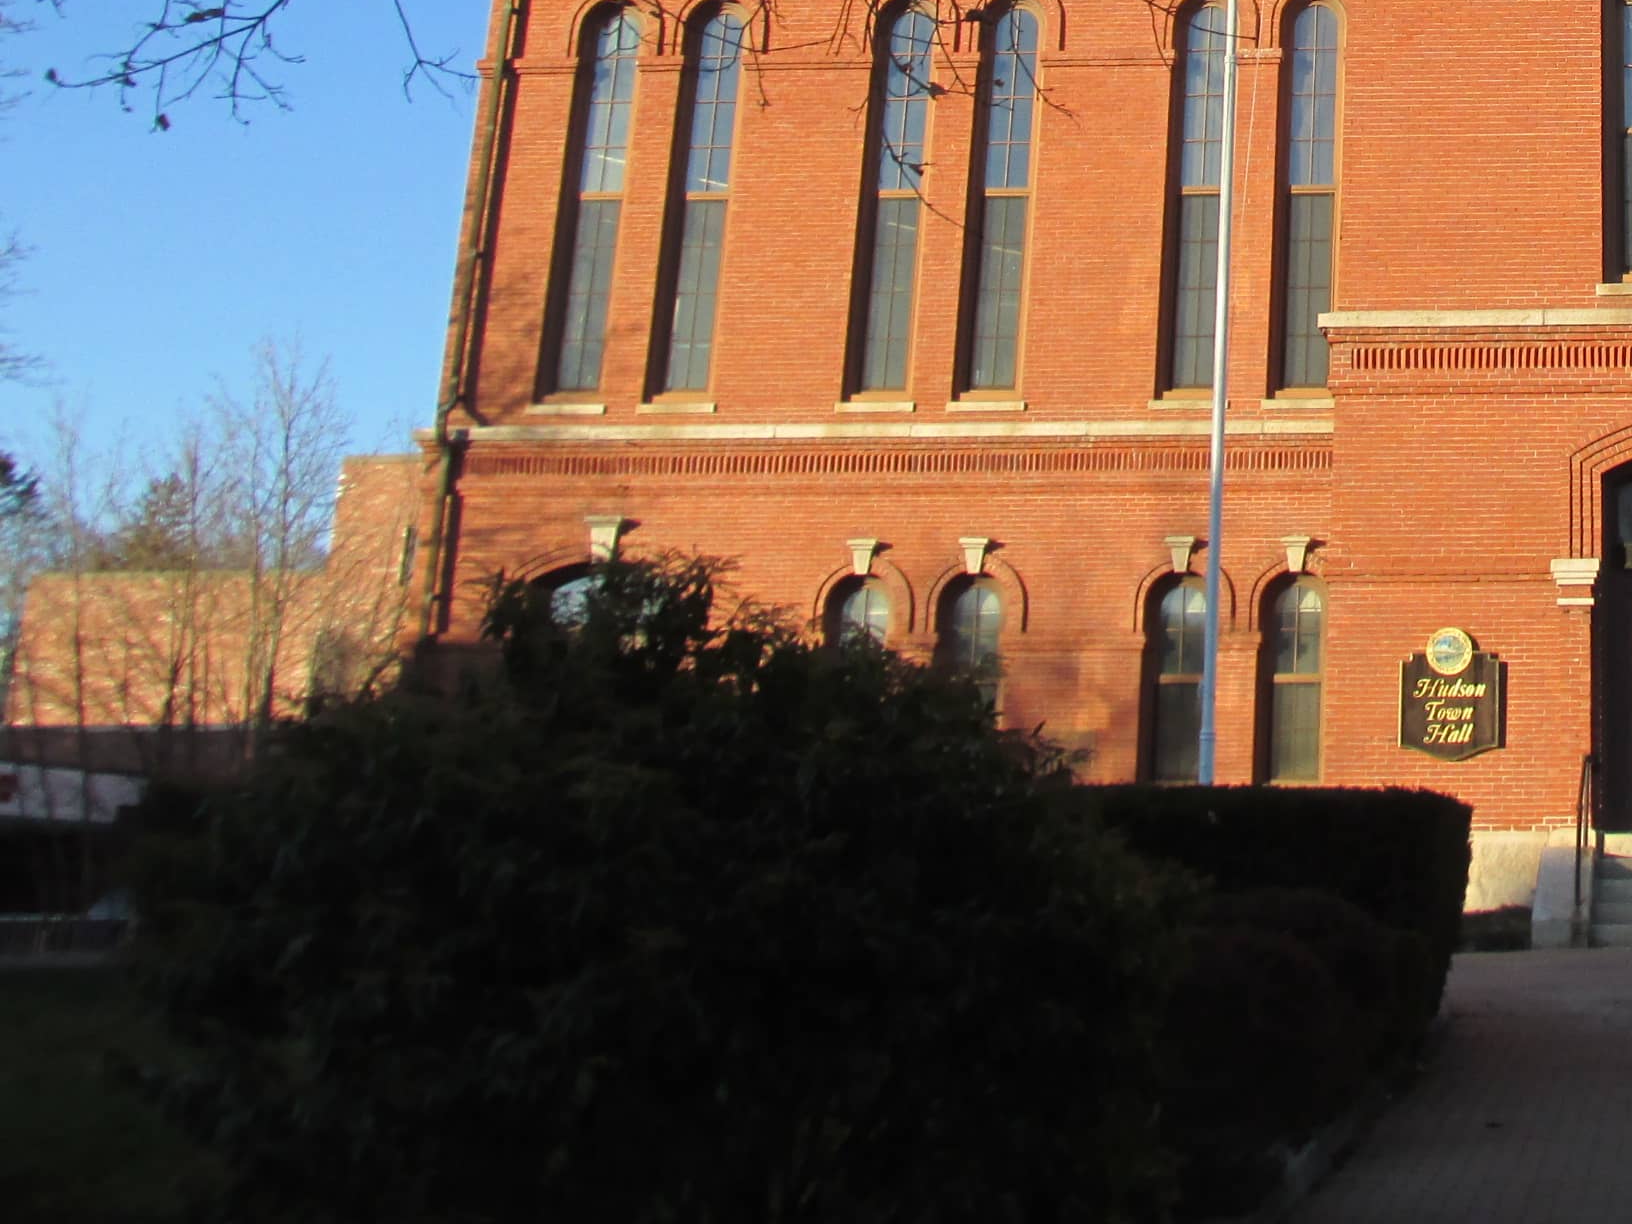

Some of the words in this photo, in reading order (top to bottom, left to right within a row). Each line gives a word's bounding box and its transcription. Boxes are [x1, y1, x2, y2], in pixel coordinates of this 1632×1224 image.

[1413, 678, 1486, 698] Hudson
[1424, 699, 1474, 721] Town
[1423, 723, 1474, 744] Hall
